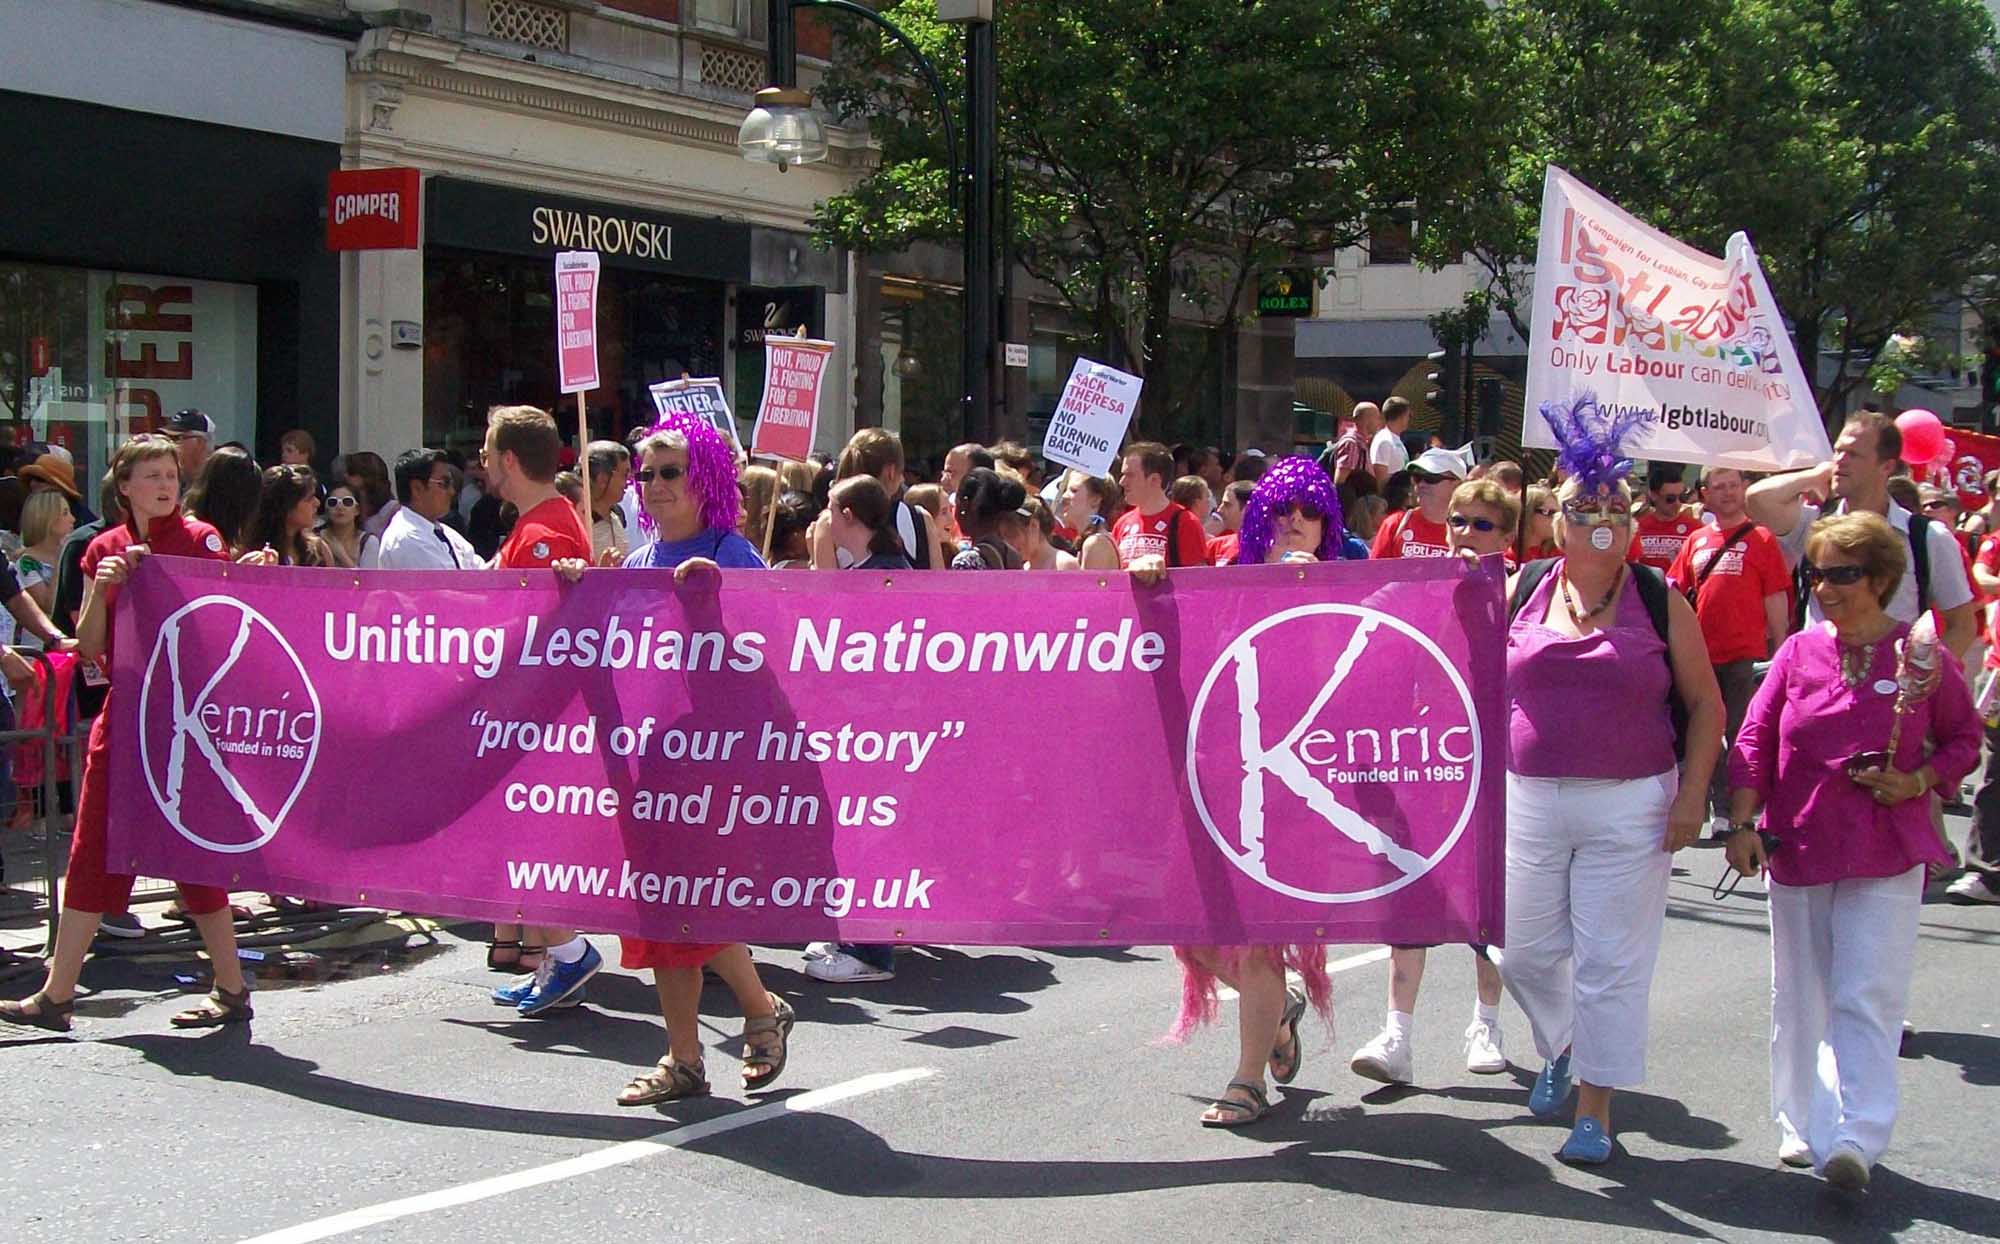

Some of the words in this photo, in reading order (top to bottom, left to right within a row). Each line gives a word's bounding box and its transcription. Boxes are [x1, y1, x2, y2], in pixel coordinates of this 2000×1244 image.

[335, 192, 400, 226] CAMPER
[532, 206, 673, 262] SWAROVSKI
[1588, 219, 1634, 253] Campaign
[1636, 250, 1652, 263] for
[1692, 276, 1708, 290] Gay
[1261, 297, 1309, 309] ROLEX
[795, 352, 822, 372] PROUD
[1551, 346, 1598, 375] Only
[1606, 354, 1685, 380] Labour
[1691, 365, 1722, 384] can
[771, 367, 779, 385] &
[781, 369, 815, 391] FIGHTING
[1075, 372, 1107, 393] SACK
[660, 393, 714, 414] NEVER
[768, 387, 786, 405] FOR
[1069, 384, 1125, 415] THERESA
[763, 405, 811, 428] LIBERATION
[1057, 410, 1076, 426] NO
[1048, 435, 1082, 457] BACK
[1052, 422, 1109, 453] TURNING
[323, 611, 505, 678] Uniting
[519, 615, 768, 674] Lesbians
[789, 617, 1166, 674] Nationwide
[215, 738, 260, 756] Founded
[261, 742, 273, 757] in
[276, 744, 305, 760] 1965
[610, 717, 656, 756] of
[662, 728, 744, 761] our
[1327, 767, 1399, 784] Founded
[1403, 766, 1419, 783] in
[1424, 765, 1466, 782] 1965
[505, 781, 620, 818] come
[632, 784, 713, 825] and
[717, 784, 820, 836] join
[837, 793, 899, 827] us
[507, 859, 936, 918] www.kenric.org.uk
